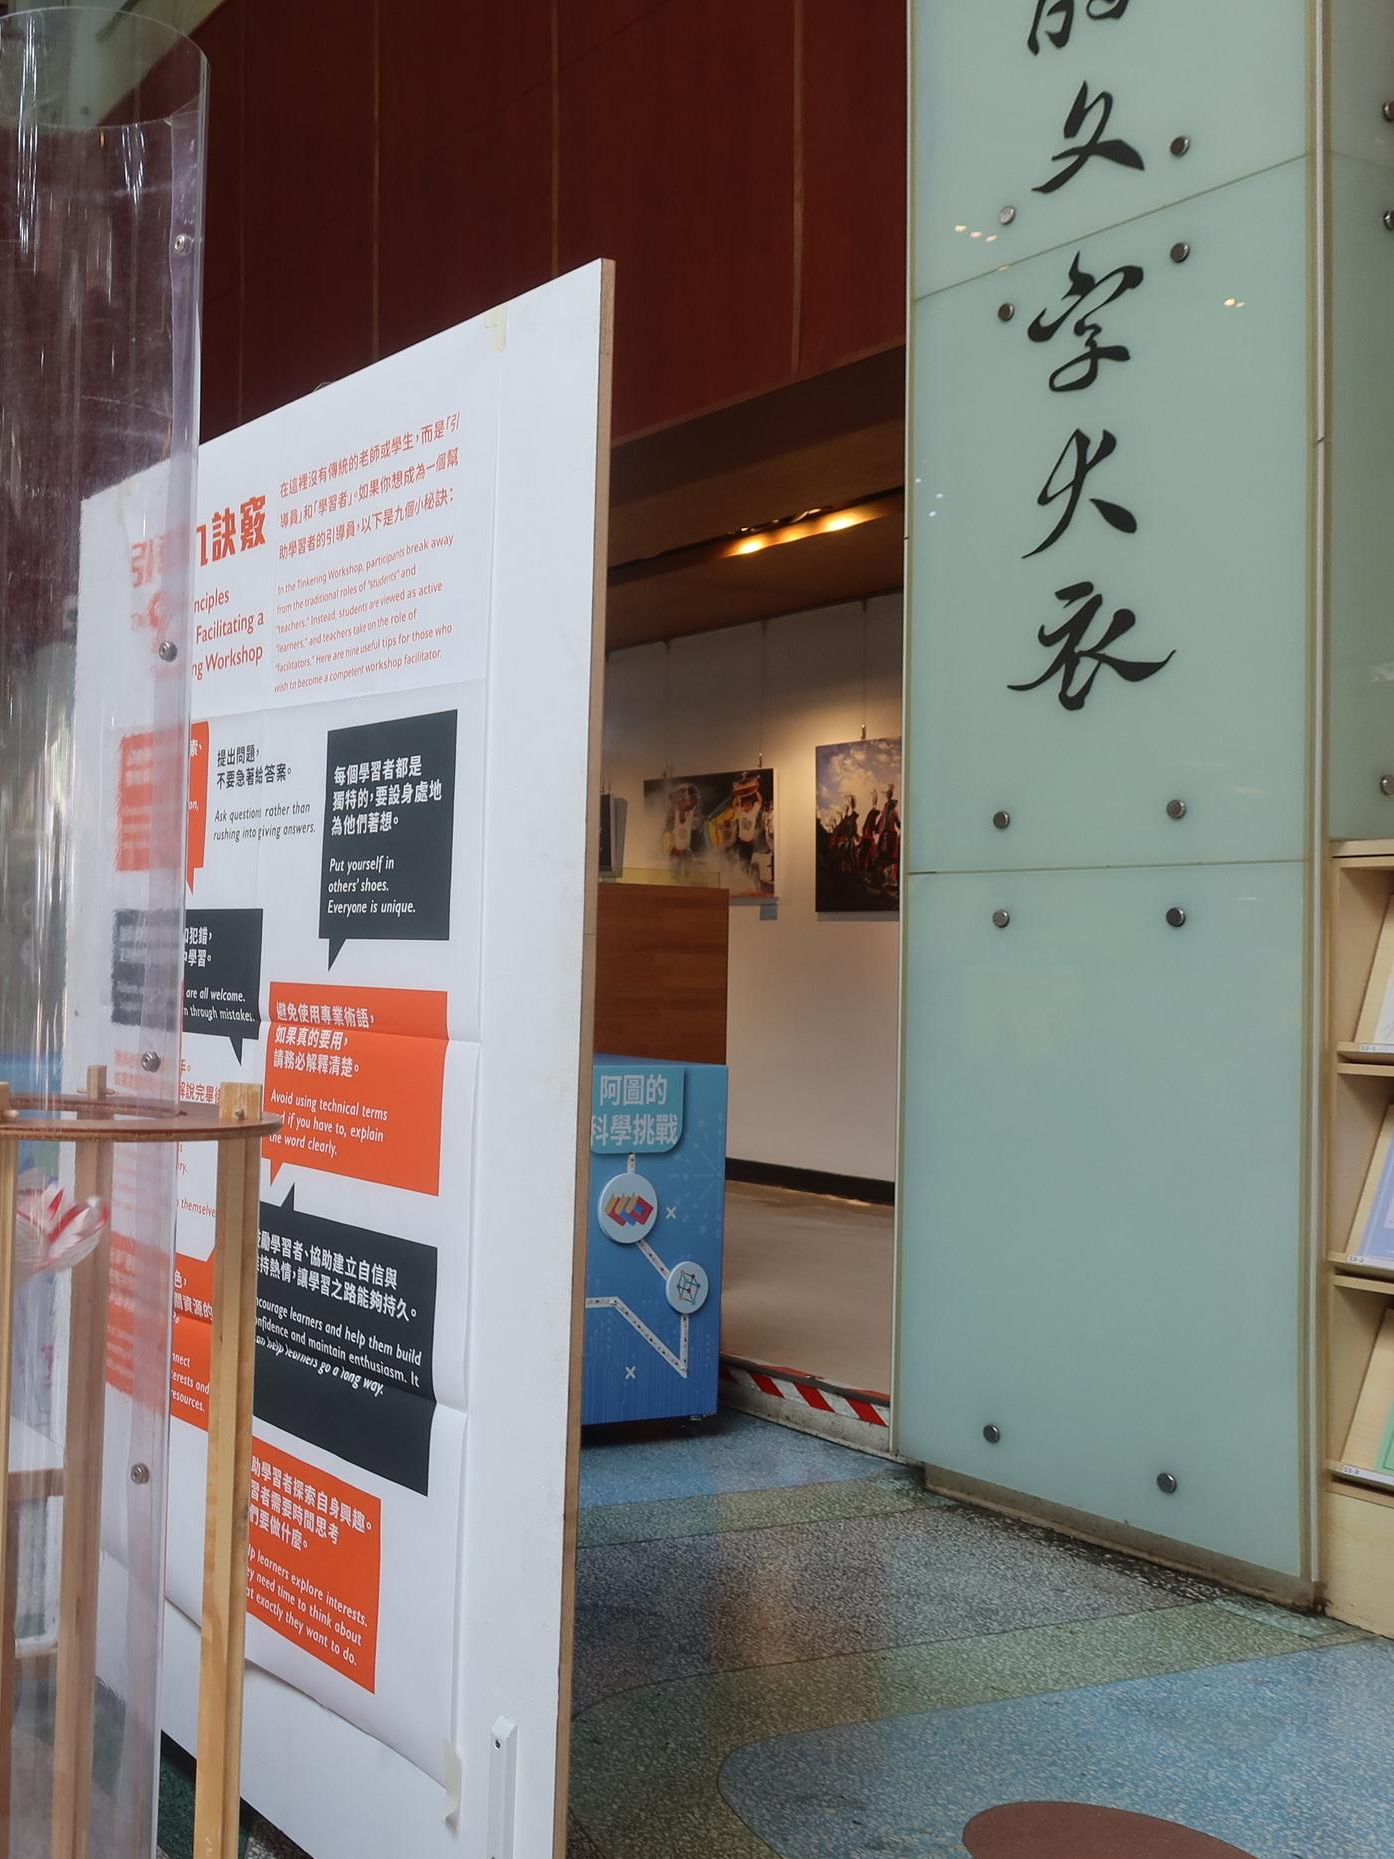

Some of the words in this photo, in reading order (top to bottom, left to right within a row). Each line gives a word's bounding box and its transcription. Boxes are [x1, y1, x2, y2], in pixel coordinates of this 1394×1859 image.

[286, 582, 295, 592] the
[298, 572, 326, 590] Tinkering
[328, 562, 364, 580] Workshop,
[366, 548, 405, 572] participants
[406, 540, 428, 555] break
[431, 535, 454, 551] away
[194, 588, 229, 613] nciples
[277, 604, 291, 616] from
[293, 600, 303, 611] the
[305, 589, 338, 608] traditional
[340, 584, 357, 597] roles
[401, 565, 416, 578] and
[311, 613, 337, 625] Instead,
[339, 602, 368, 618] students
[381, 590, 405, 606] viewed
[419, 582, 443, 596] active
[196, 614, 254, 644] Facilitating
[258, 613, 264, 625] a
[309, 632, 322, 646] and
[323, 628, 351, 643] teachers
[353, 622, 366, 635] take
[377, 616, 388, 627] the
[391, 611, 406, 624] role
[316, 653, 331, 665] Here
[346, 646, 359, 658] nine
[360, 639, 380, 654] useful
[382, 635, 396, 650] tips
[398, 631, 409, 643] for
[412, 627, 433, 640] those
[435, 623, 452, 636] who
[192, 663, 203, 680] ng
[206, 646, 263, 672] Workshop
[275, 681, 288, 693] wish
[298, 674, 323, 688] become
[330, 664, 364, 683] competent
[366, 657, 402, 674] workshop
[334, 755, 422, 786] 每個學習者都是
[332, 779, 442, 811] 獨特的，要設身處地
[215, 810, 226, 822] Ask
[230, 808, 261, 824] questions
[265, 803, 290, 816] rather
[292, 801, 310, 814] than
[331, 811, 398, 836] 為他們著想。
[214, 827, 240, 842] rushing
[242, 827, 256, 838] into
[258, 824, 280, 840] giving
[283, 823, 315, 835] answers.
[330, 858, 345, 872] Put
[347, 855, 384, 875] yourself
[386, 856, 394, 869] in
[361, 878, 389, 891] shoes.
[328, 900, 367, 917] Everyone
[370, 900, 377, 913] is
[381, 900, 416, 917] unique.
[186, 989, 197, 999] are
[200, 987, 208, 999] all
[211, 988, 245, 1002] welcome.
[190, 1005, 218, 1022] through
[220, 1008, 255, 1022] mistakes.
[275, 1025, 348, 1050] 如果真的要用，
[273, 1049, 359, 1077] 請務必解釋清楚。
[270, 1089, 293, 1104] Avoid
[296, 1095, 316, 1112] using
[320, 1099, 358, 1116] technical
[362, 1106, 387, 1121] terms
[599, 1074, 668, 1106] 阿圖的
[288, 1113, 294, 1128] if
[296, 1117, 310, 1131] you
[314, 1118, 332, 1132] have
[335, 1123, 346, 1137] to,
[351, 1127, 384, 1142] explain
[591, 1113, 678, 1147] 科學挑戰
[285, 1136, 304, 1148] word
[308, 1139, 337, 1158] clearly.
[181, 1198, 215, 1217] themselve
[256, 1297, 287, 1319] courage
[290, 1306, 322, 1331] learners
[325, 1323, 341, 1338] and
[345, 1326, 365, 1349] help
[369, 1336, 392, 1355] them
[396, 1344, 421, 1366] build
[267, 1335, 284, 1357] help
[285, 1344, 318, 1368] learners
[318, 1361, 331, 1374] go
[333, 1366, 339, 1377] a
[341, 1366, 361, 1389] long
[363, 1377, 383, 1397] way.
[291, 1330, 309, 1345] and
[308, 1337, 345, 1360] maintain
[349, 1351, 407, 1383] enthusiasm.
[411, 1373, 419, 1388] It
[172, 1374, 194, 1388] erests
[196, 1383, 209, 1395] and
[257, 1549, 289, 1581] learners
[291, 1572, 324, 1601] explore
[326, 1591, 368, 1627] interests.
[256, 1571, 275, 1592] need
[277, 1585, 295, 1605] time
[298, 1597, 306, 1612] to
[310, 1604, 332, 1628] think
[335, 1620, 361, 1646] about
[256, 1593, 283, 1621] exactly
[285, 1611, 303, 1635] they
[306, 1626, 328, 1648] want
[331, 1639, 340, 1654] to
[343, 1645, 357, 1666] do.
